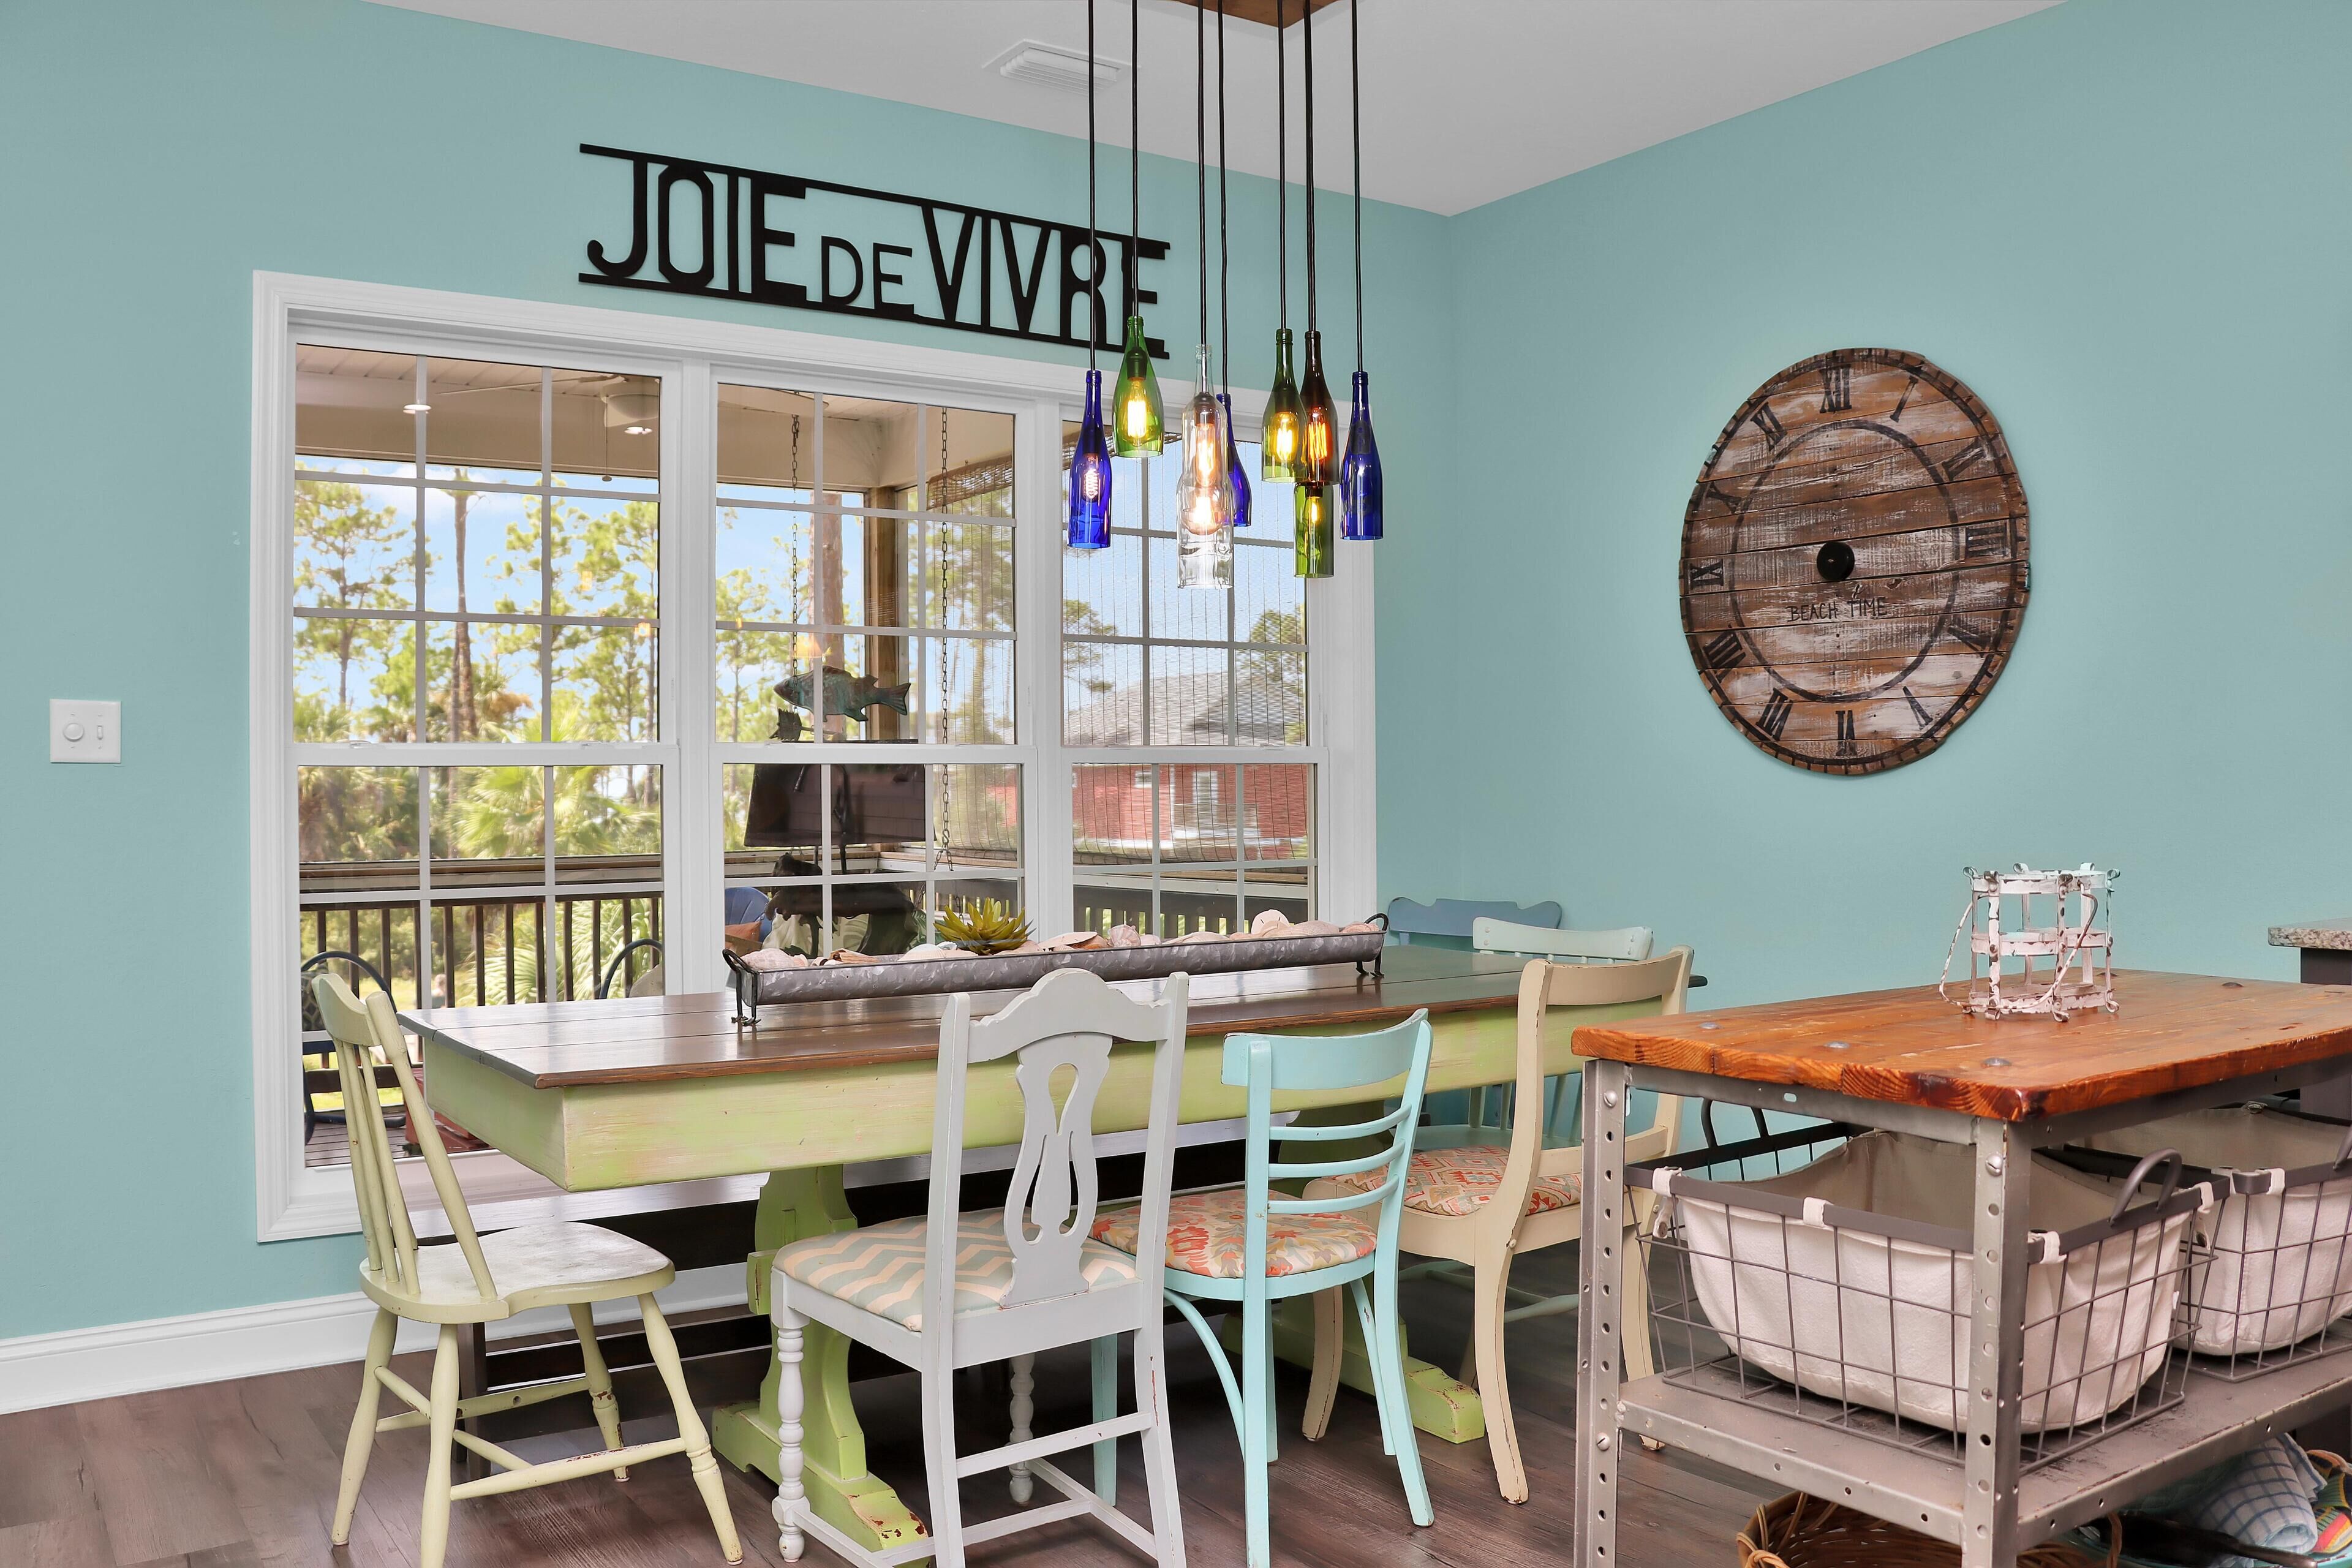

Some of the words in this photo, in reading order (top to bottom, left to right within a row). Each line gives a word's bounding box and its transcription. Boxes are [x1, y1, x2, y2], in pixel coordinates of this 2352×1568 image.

[585, 153, 807, 301] JOIE
[820, 235, 914, 315] DE
[920, 204, 1167, 357] VIVRE
[1819, 364, 1852, 413] XII
[1890, 375, 1918, 423] I
[1750, 401, 1788, 451] XI
[1942, 437, 1988, 481] II
[1706, 482, 1743, 514] X
[1965, 522, 2007, 559] III
[1689, 558, 1724, 590] IX
[1786, 601, 1838, 622] BEACH
[1847, 597, 1888, 618] TIME
[1702, 624, 1746, 684] VIII
[1755, 687, 1794, 741] VII
[1902, 685, 1933, 731] V
[1836, 709, 1858, 756] VI
